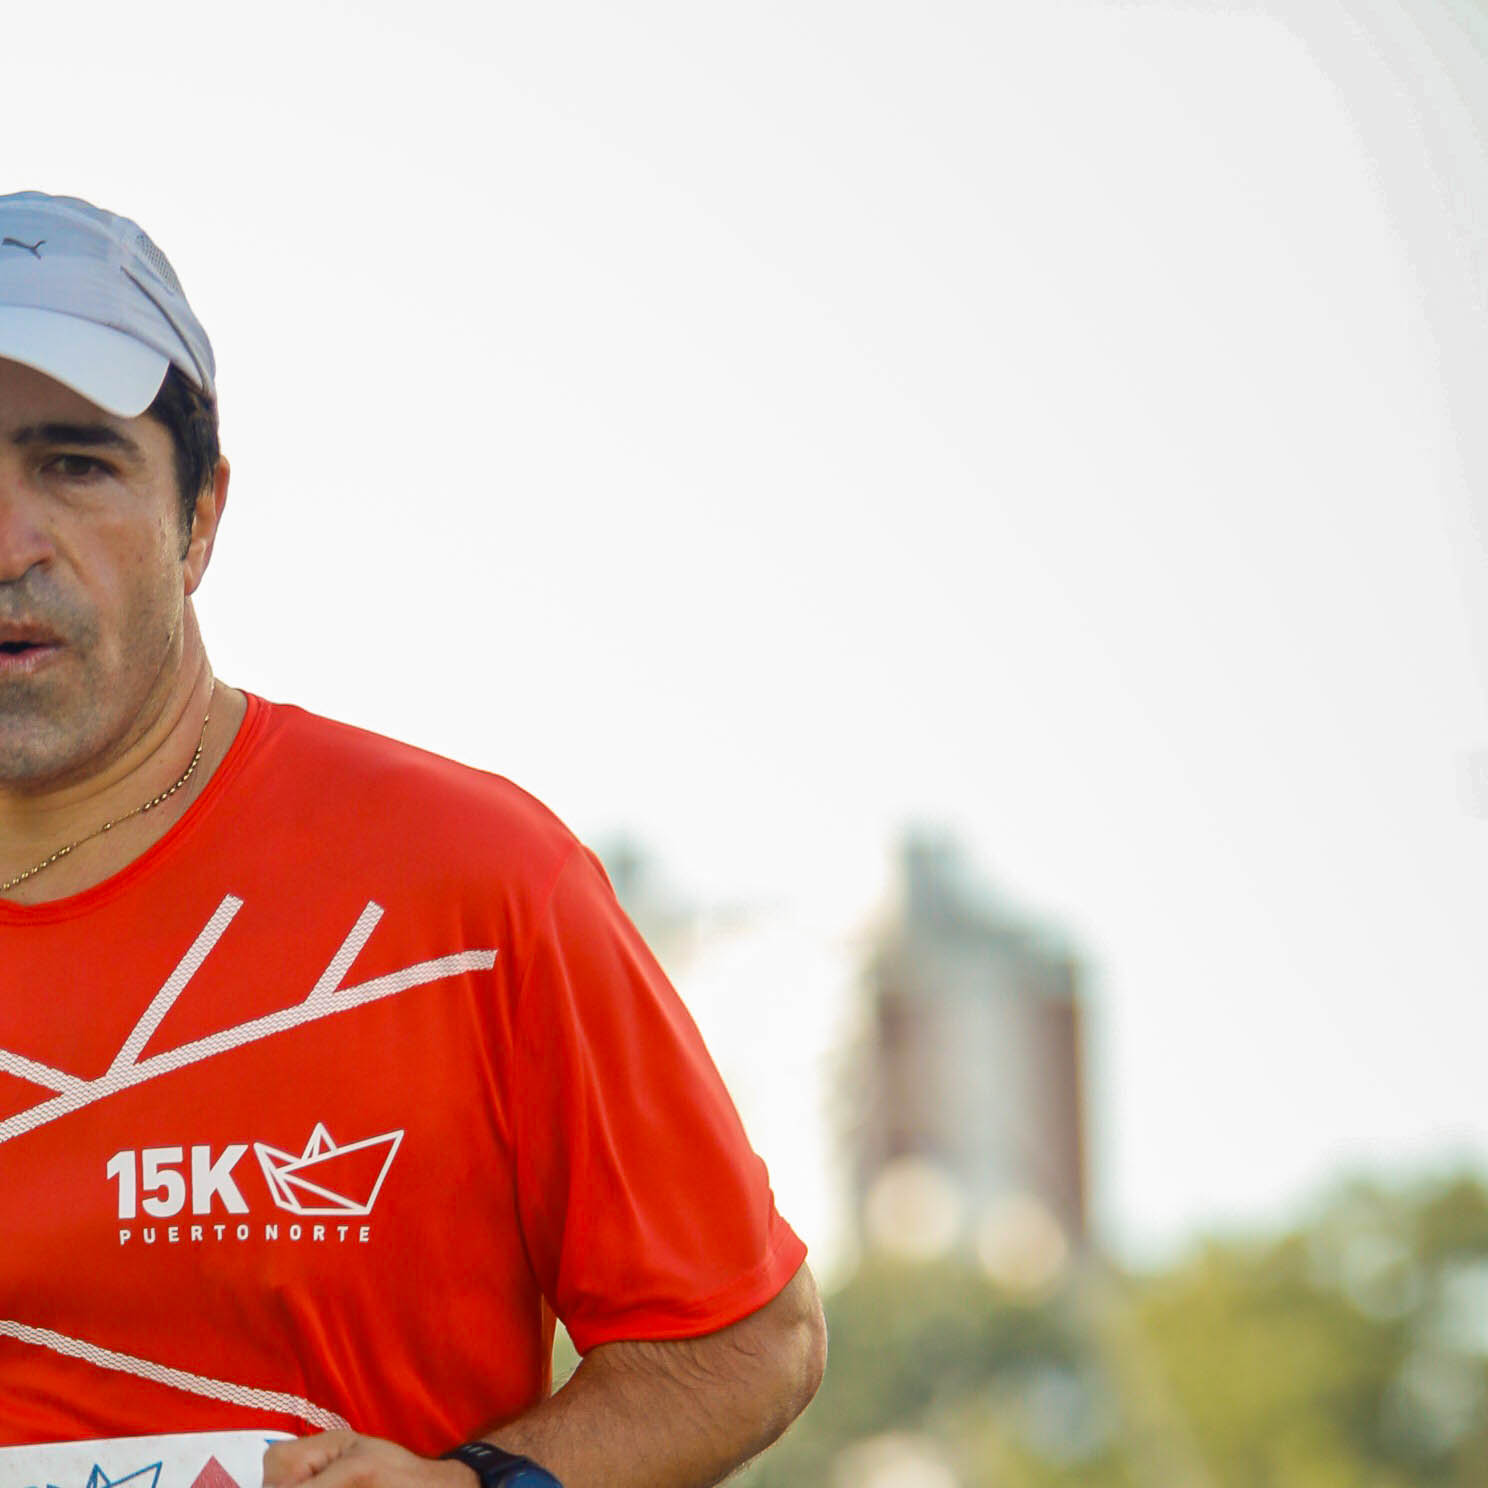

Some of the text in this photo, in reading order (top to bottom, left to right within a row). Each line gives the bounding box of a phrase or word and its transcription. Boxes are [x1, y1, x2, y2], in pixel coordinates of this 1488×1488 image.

[106, 1144, 250, 1220] 15K
[119, 1223, 371, 1246] PUERTO NORTE
